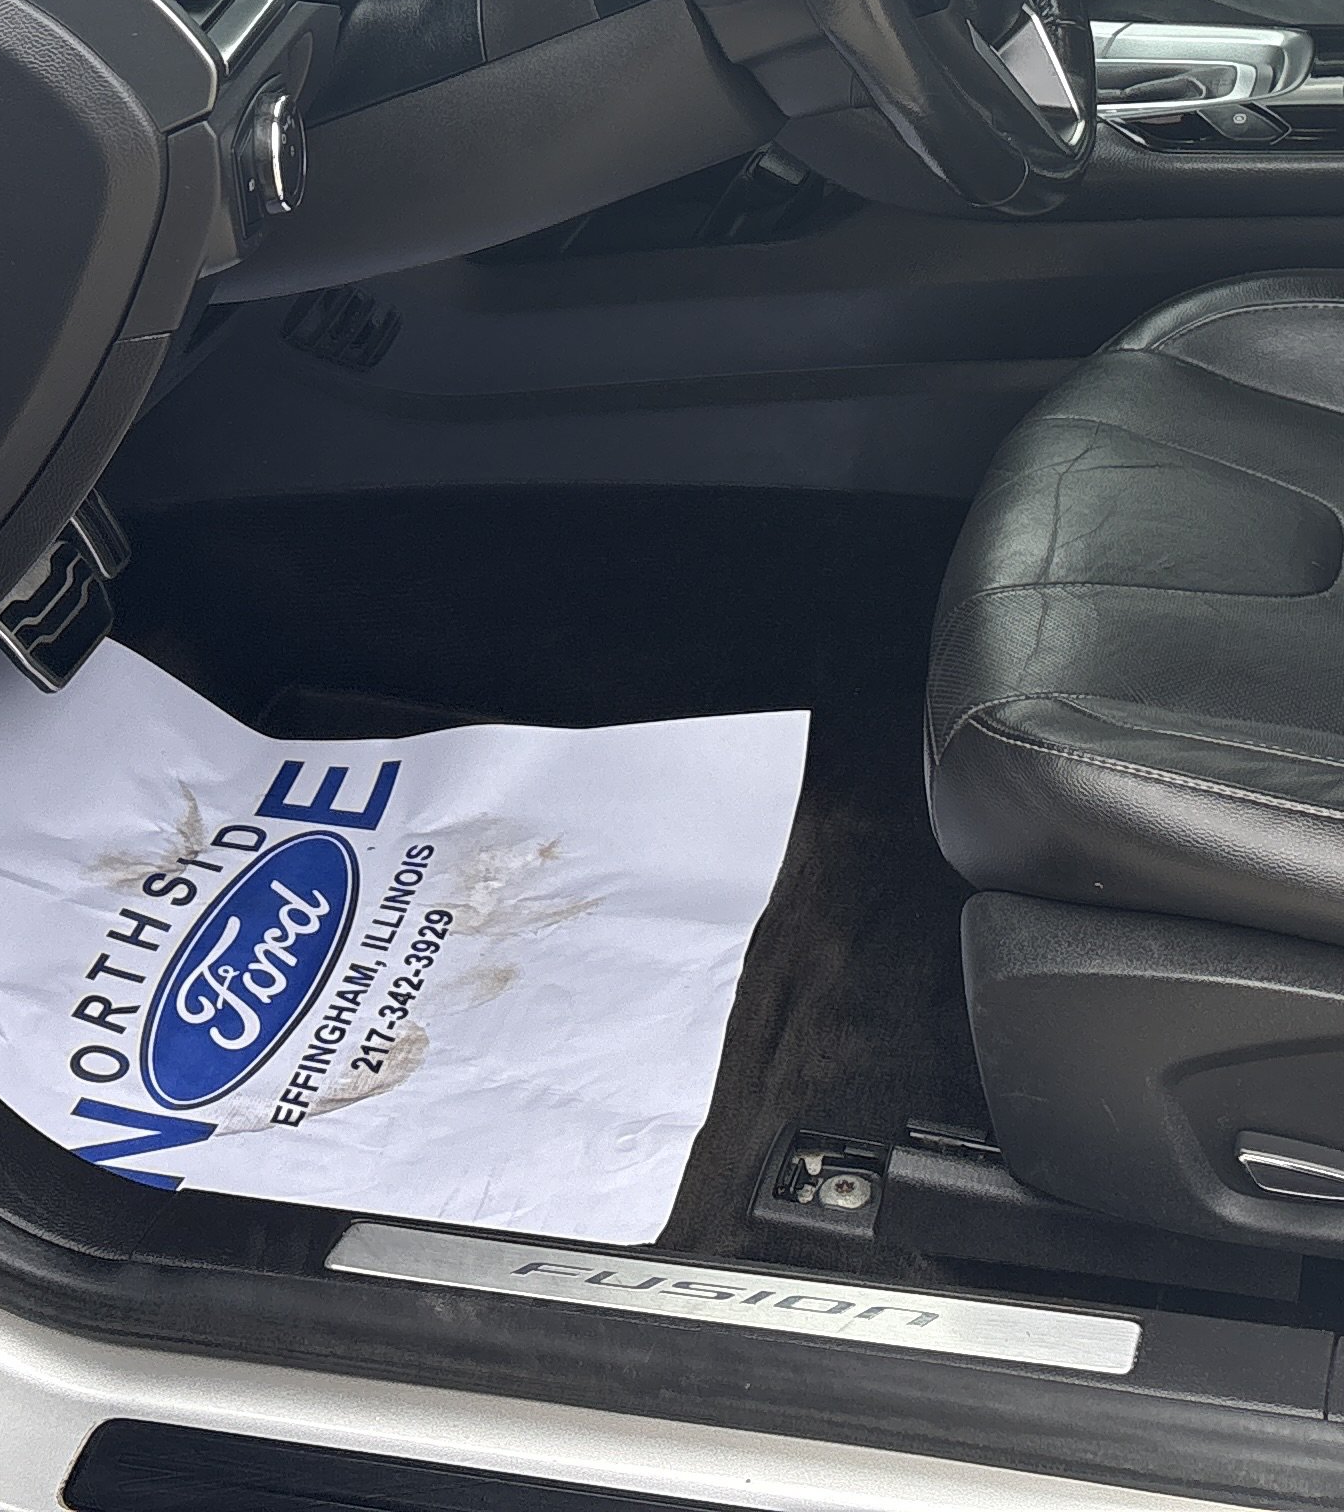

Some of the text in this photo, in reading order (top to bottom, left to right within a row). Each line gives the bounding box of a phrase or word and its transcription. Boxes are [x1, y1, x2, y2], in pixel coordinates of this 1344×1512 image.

[70, 760, 402, 1192] NORTHSIDE
[176, 879, 331, 1050] Ford
[270, 843, 435, 1127] EFFINGHAM, ILLINOIS
[351, 909, 453, 1073] 217-342-3929
[510, 1262, 940, 1327] FUSION
